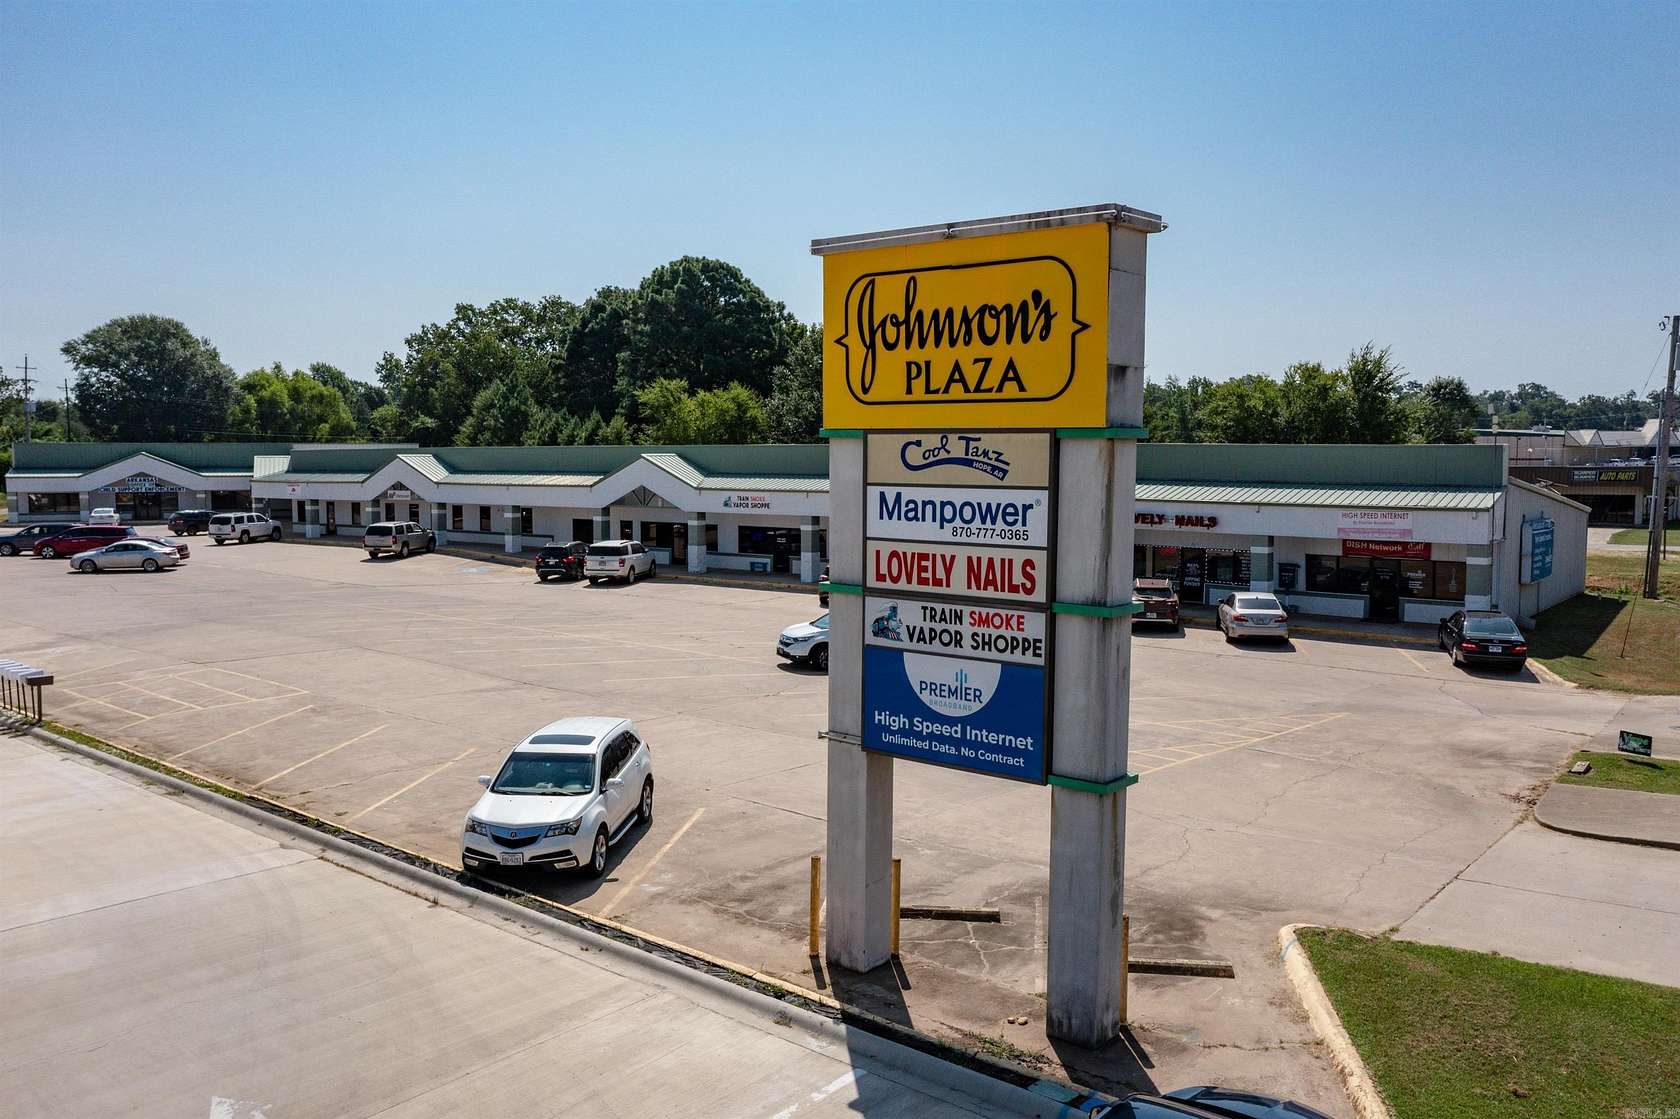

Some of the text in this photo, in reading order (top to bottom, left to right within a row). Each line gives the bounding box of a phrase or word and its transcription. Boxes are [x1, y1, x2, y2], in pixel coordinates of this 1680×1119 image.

[857, 275, 1058, 396] Johnson's
[904, 356, 1028, 395] PLAZA
[900, 434, 1011, 472] Cool Tanz
[1600, 471, 1636, 480] AUTO PARTS
[878, 490, 1034, 530] Manpower
[1175, 515, 1217, 529] NAILS
[1380, 512, 1409, 520] INTERNET
[951, 526, 1029, 541] 870-777-0365
[1368, 542, 1403, 553] Network
[875, 549, 1037, 597] LOVELY NAILS
[921, 605, 1026, 633] TRAIN SMOKE
[905, 624, 1043, 658] VAPOR SHOPPE
[919, 669, 984, 704] PREMIER
[874, 710, 1035, 752] High Speed Internet
[881, 732, 1025, 768] Unlimited Data. No Contract
